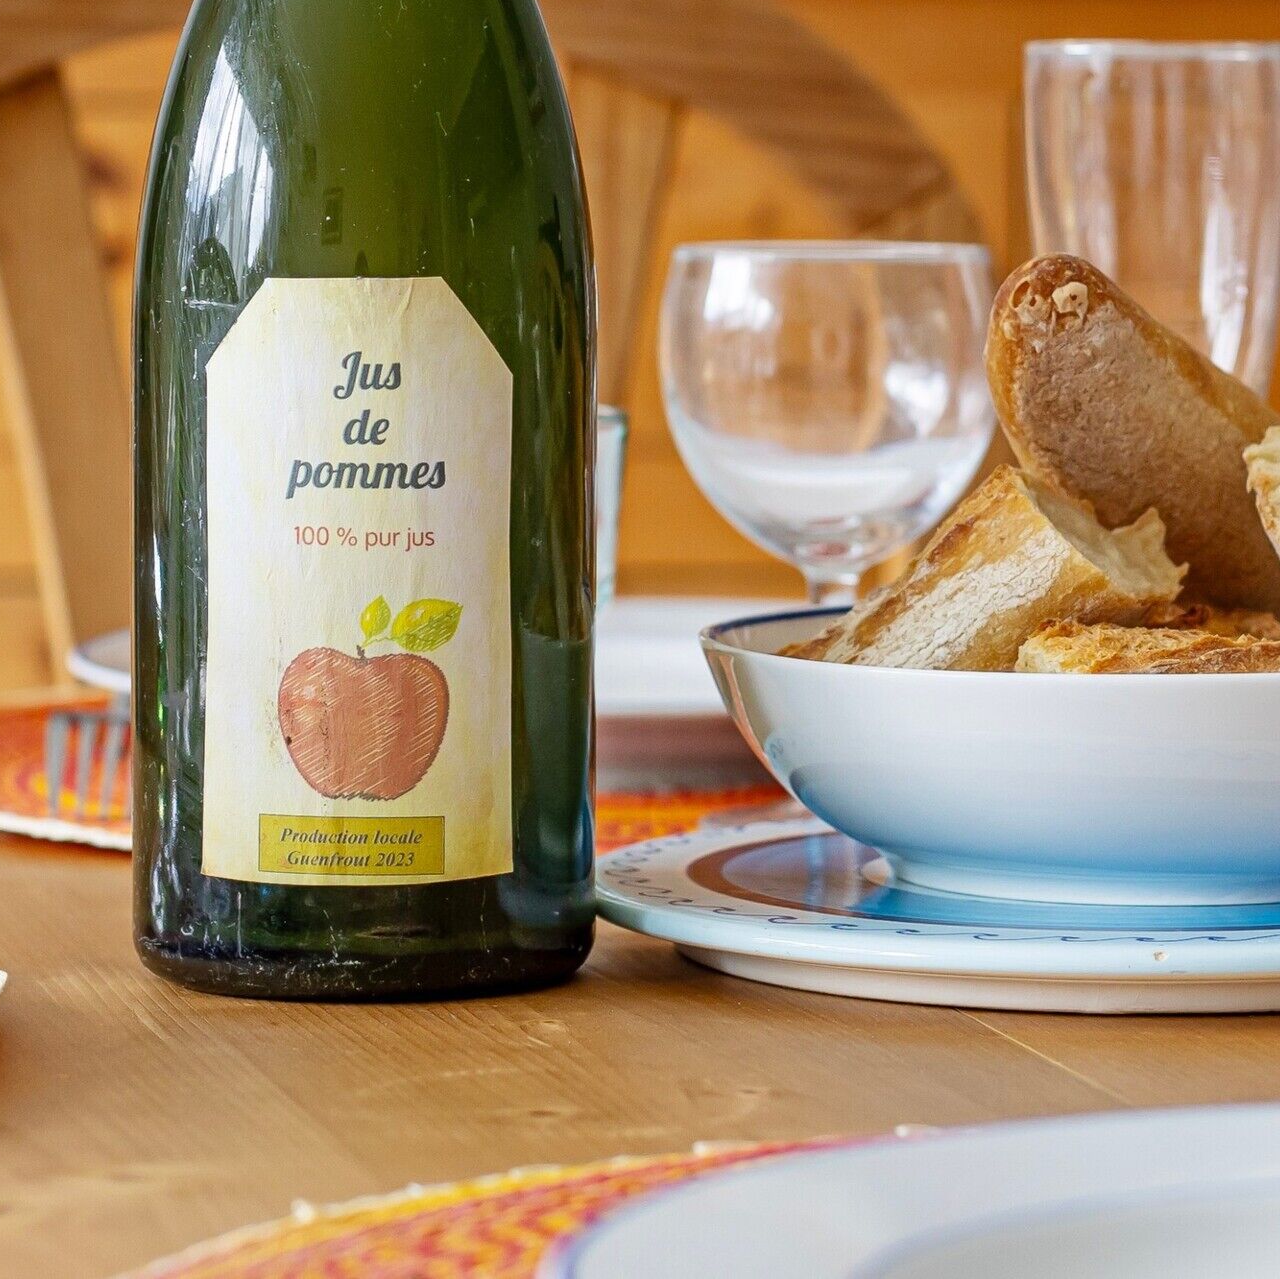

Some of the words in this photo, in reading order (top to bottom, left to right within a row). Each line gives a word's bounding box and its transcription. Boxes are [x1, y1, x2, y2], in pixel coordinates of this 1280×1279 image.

[333, 351, 402, 400] Jus
[342, 409, 390, 446] de
[285, 459, 447, 500] pommes
[293, 526, 330, 547] 100
[336, 527, 358, 547] %
[365, 530, 401, 552] pur
[404, 528, 436, 552] jus
[280, 828, 368, 845] Production
[373, 829, 423, 845] locale
[287, 851, 371, 868] Guenfrout
[375, 852, 416, 868] 2023
